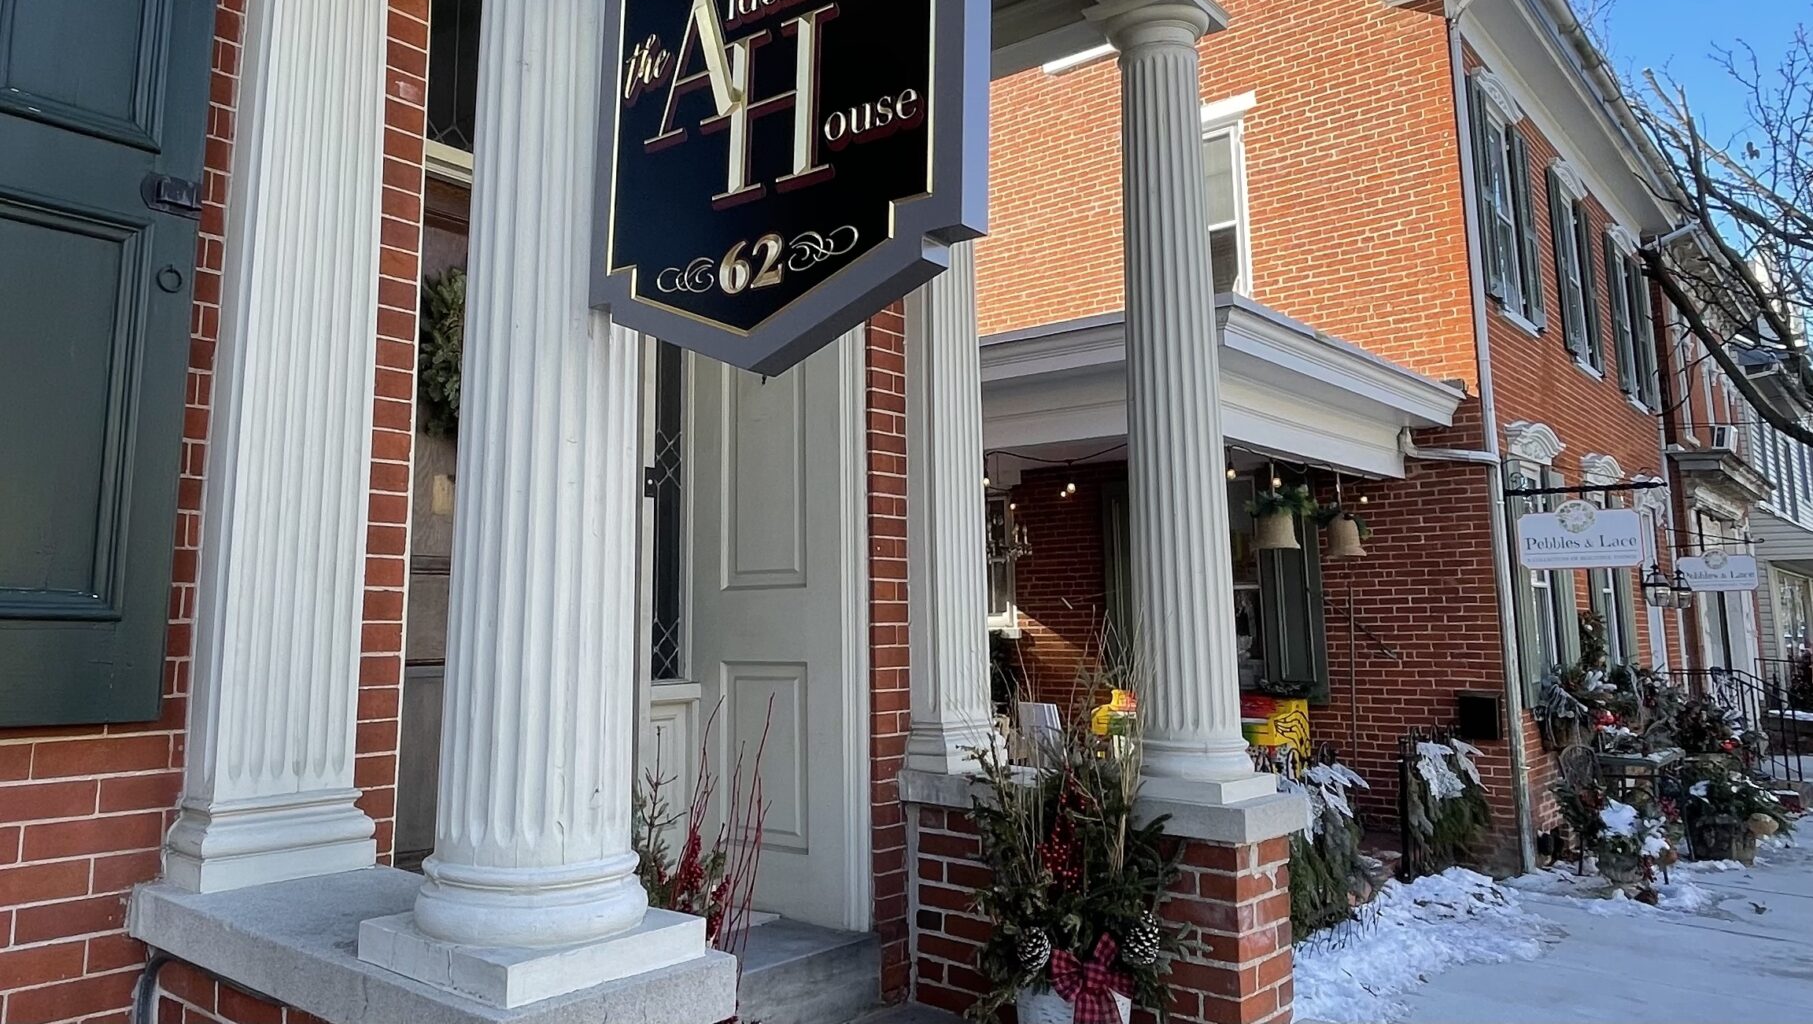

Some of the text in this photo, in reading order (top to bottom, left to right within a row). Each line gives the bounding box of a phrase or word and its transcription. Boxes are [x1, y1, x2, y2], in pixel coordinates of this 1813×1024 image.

[624, 33, 671, 100] the
[699, 3, 918, 202] House
[719, 233, 784, 295] 62
[1525, 534, 1637, 550] Pebbles & Lace
